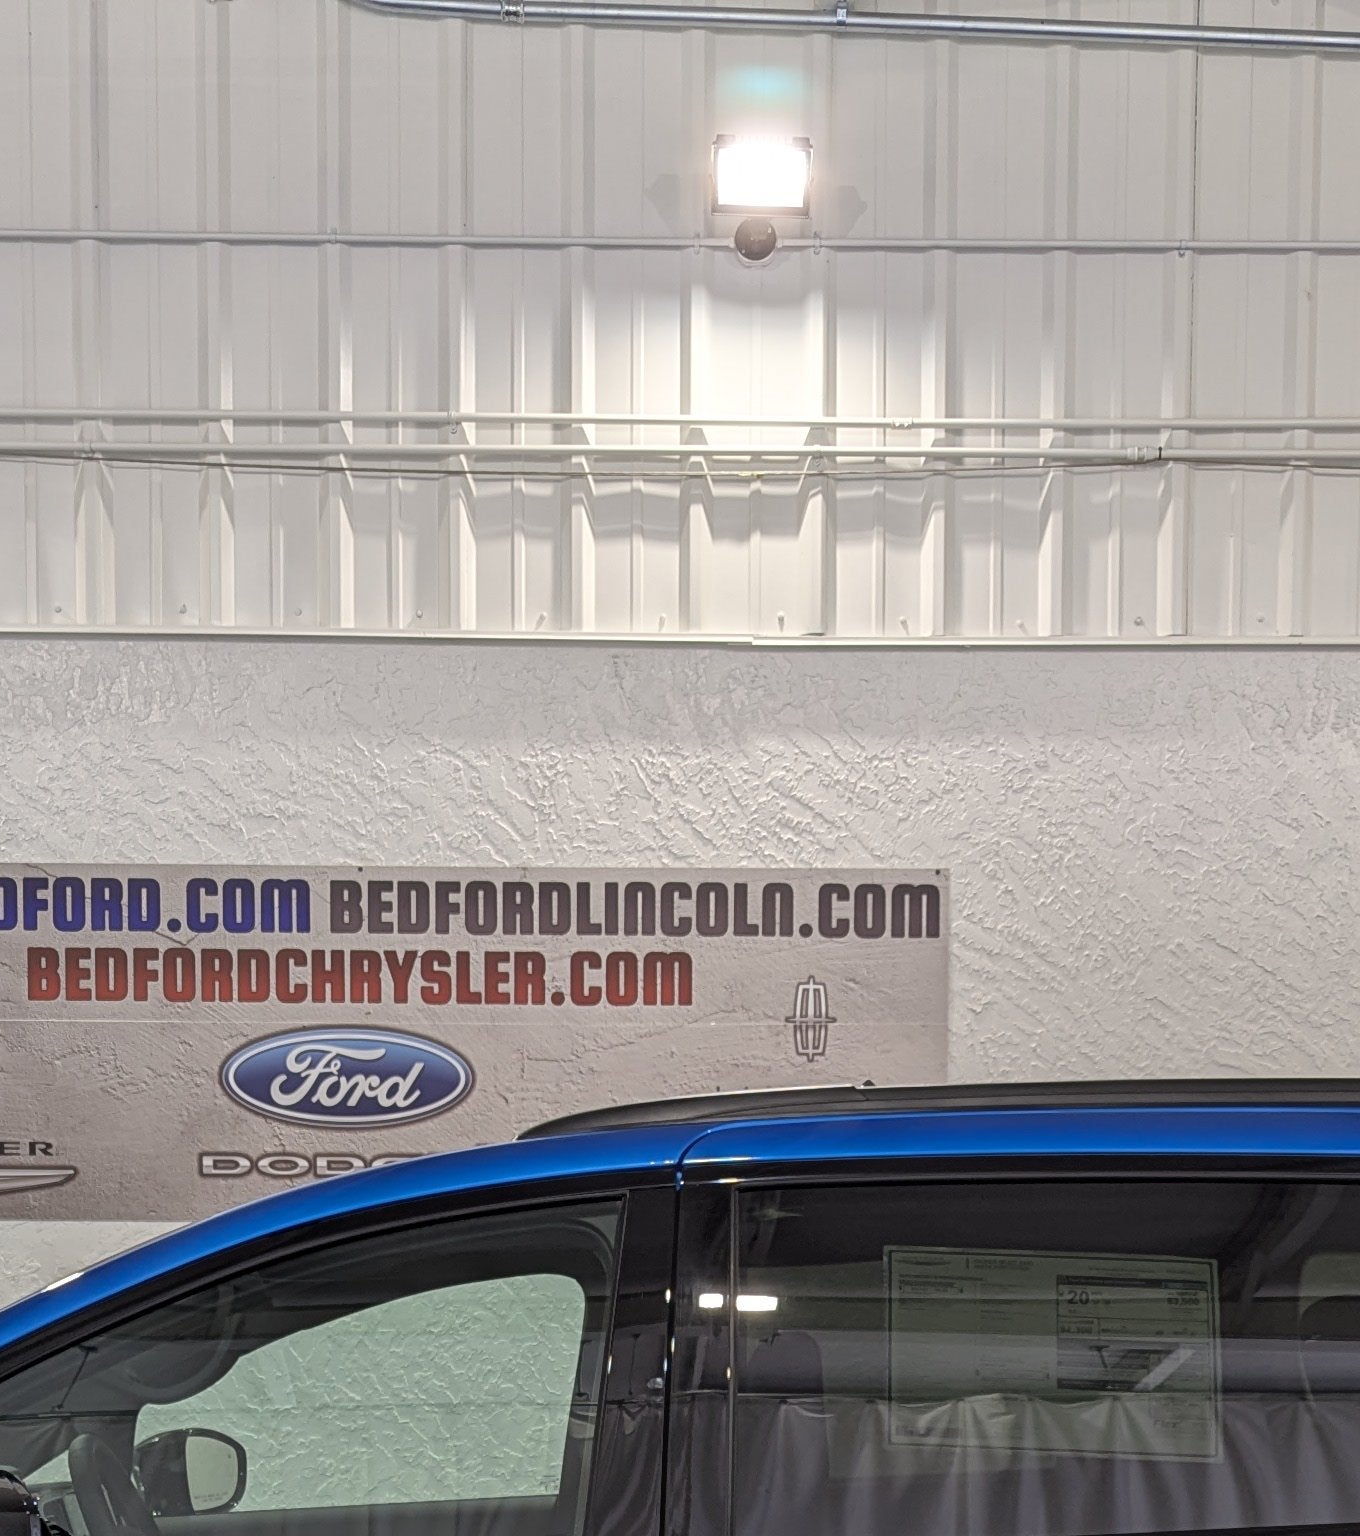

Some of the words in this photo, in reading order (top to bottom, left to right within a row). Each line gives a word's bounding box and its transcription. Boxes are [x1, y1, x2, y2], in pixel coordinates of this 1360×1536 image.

[328, 879, 941, 939] BEDFORDLINCOLN.COM
[26, 946, 693, 1006] BEDFORDCHRYSLER.COM
[269, 1044, 425, 1108] Ford
[201, 1154, 417, 1176] DOD
